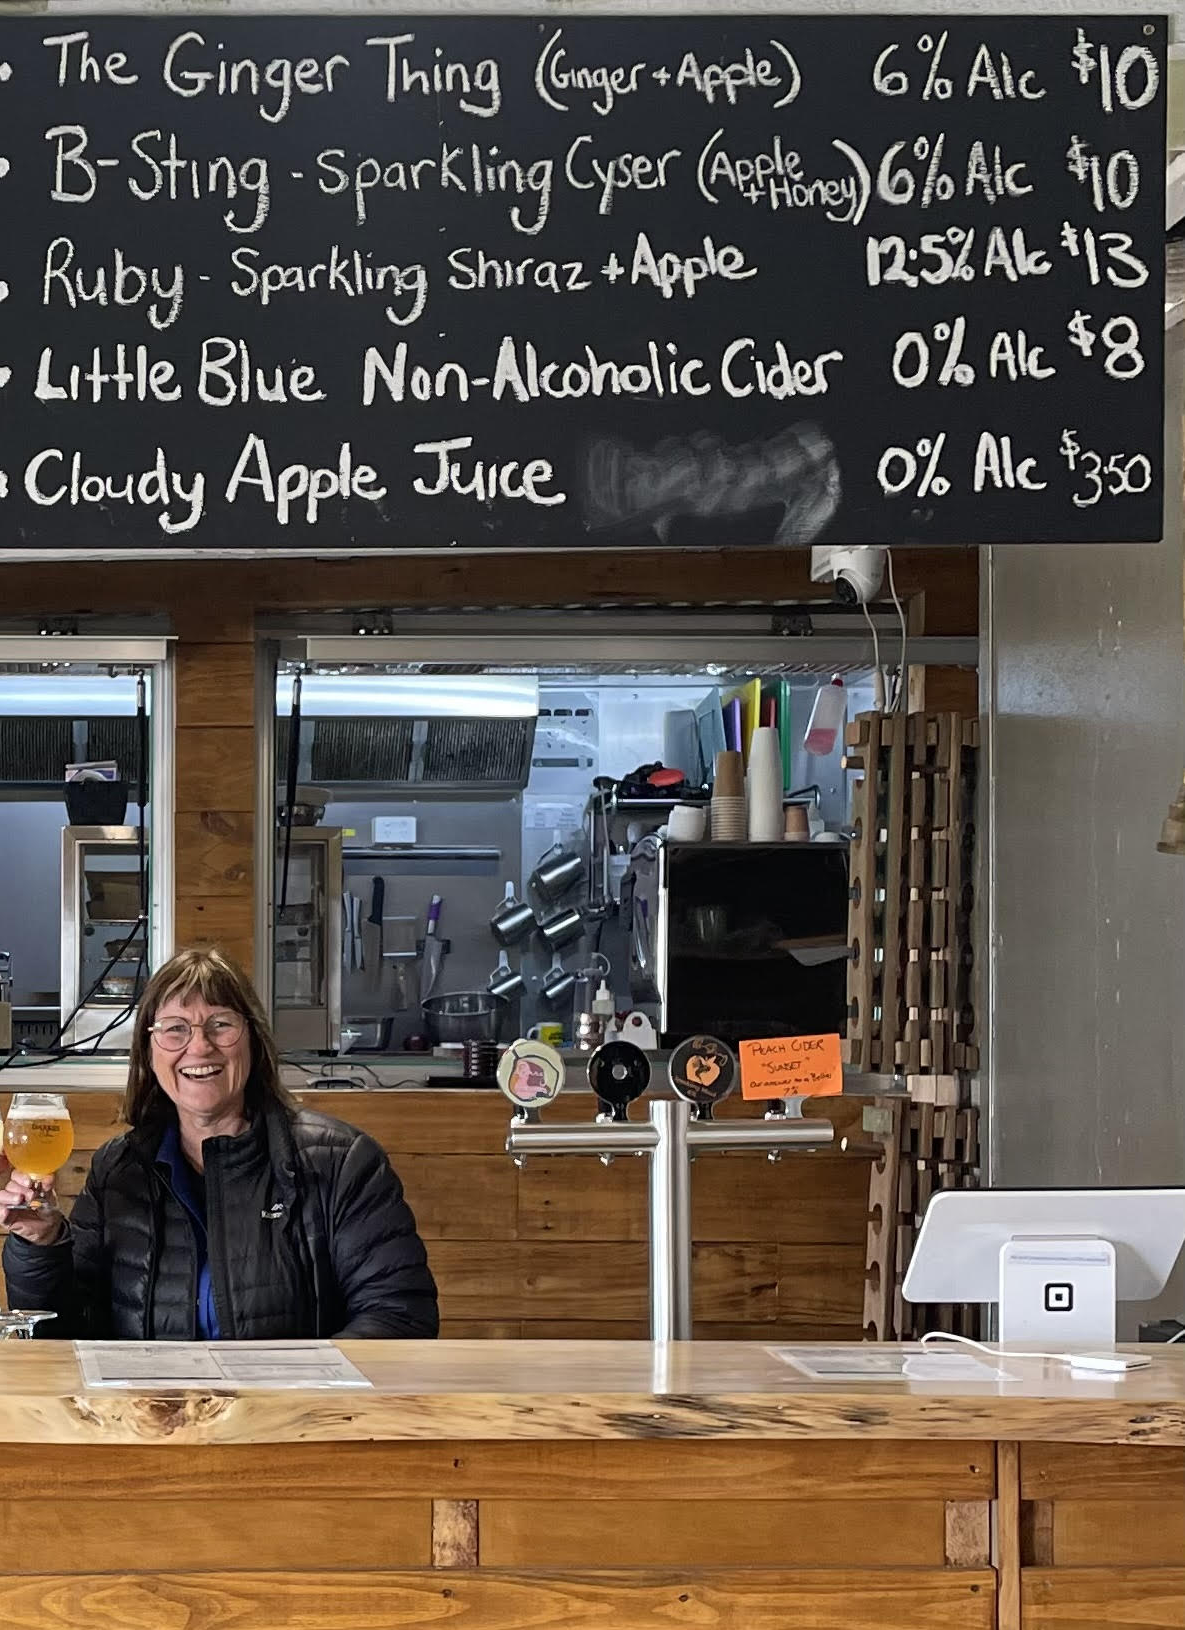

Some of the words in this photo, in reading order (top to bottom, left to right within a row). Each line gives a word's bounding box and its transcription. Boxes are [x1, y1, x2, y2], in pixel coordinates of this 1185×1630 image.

[42, 31, 139, 87] The
[163, 31, 350, 123] Ginger
[365, 33, 501, 118] Thing
[873, 30, 953, 101] 6%
[967, 44, 1046, 100] Alc
[1071, 25, 1159, 112] $10
[45, 124, 270, 234] B-Sting
[316, 143, 553, 235] Sparkling
[565, 135, 682, 215] Cyser
[876, 132, 955, 209] 6%
[965, 140, 1033, 205] Alc
[1066, 135, 1139, 212] $10
[43, 237, 184, 331] Ruby
[231, 244, 428, 326] Sparkling
[447, 247, 591, 293] Shiraz
[984, 226, 1053, 282] Alc
[1060, 221, 1149, 288] $13
[33, 343, 182, 403] Little
[197, 336, 327, 407] Blue
[362, 333, 712, 406] Non-Alcoholic
[721, 337, 844, 401] Cider
[892, 316, 976, 389] 0%
[989, 329, 1056, 381] Alc
[1067, 309, 1145, 381] $8
[24, 447, 206, 535] Cloudy
[225, 432, 387, 525] Apple
[413, 436, 567, 507] Juice
[877, 432, 951, 498] 0%
[973, 431, 1047, 492] Alc
[747, 1042, 786, 1056] PEACH
[791, 1039, 824, 1051] CIDER
